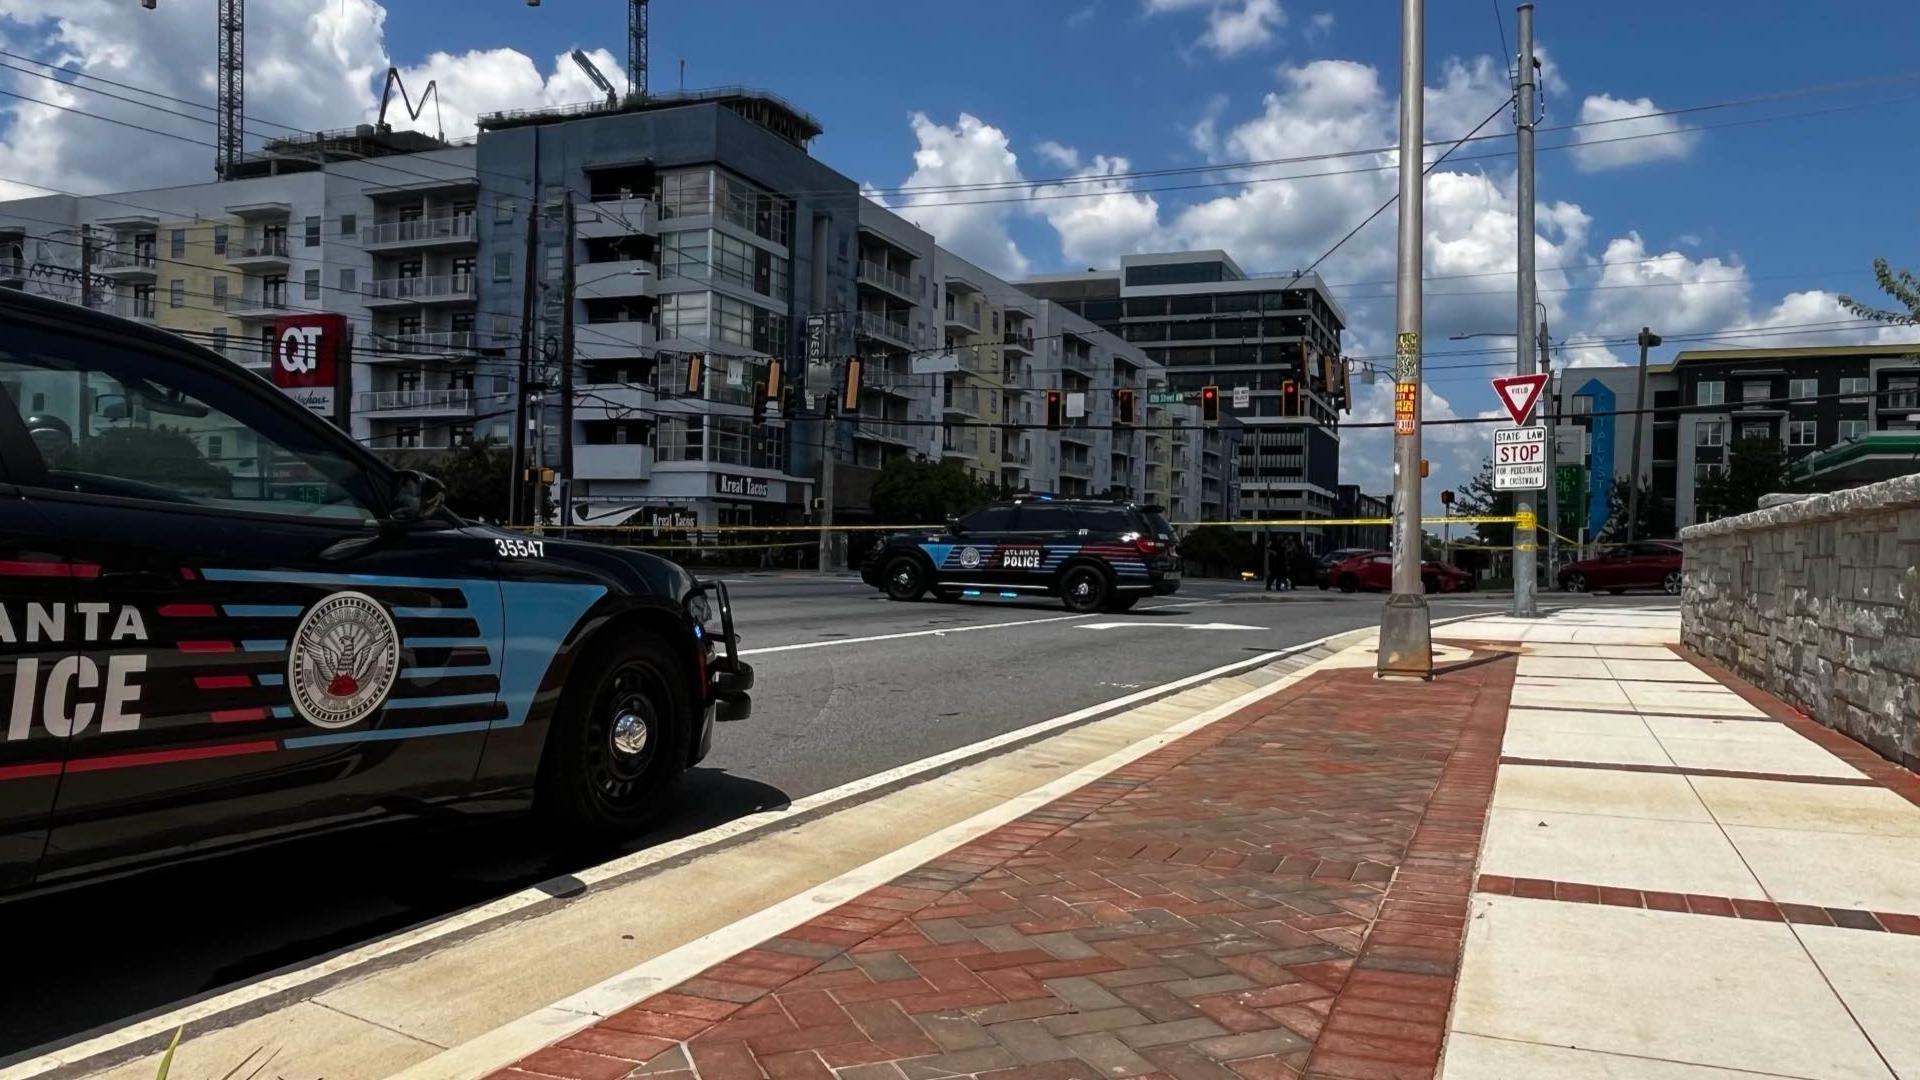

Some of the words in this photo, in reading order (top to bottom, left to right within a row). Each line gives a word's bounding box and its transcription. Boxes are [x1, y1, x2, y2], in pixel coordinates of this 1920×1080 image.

[279, 326, 323, 374] QT
[1511, 386, 1529, 395] YIELD
[1497, 431, 1521, 442] STATE
[1527, 430, 1544, 440] LAW
[1500, 444, 1540, 463] STOP
[1496, 467, 1507, 475] FOR
[1510, 465, 1543, 475] PEDESTRIANS
[746, 477, 768, 496] Tacos
[1509, 476, 1539, 486] CROSSWALK
[674, 512, 696, 527] Tacos
[494, 538, 545, 558] 35547
[1003, 556, 1040, 568] POLICE
[7, 654, 148, 741] ICE
